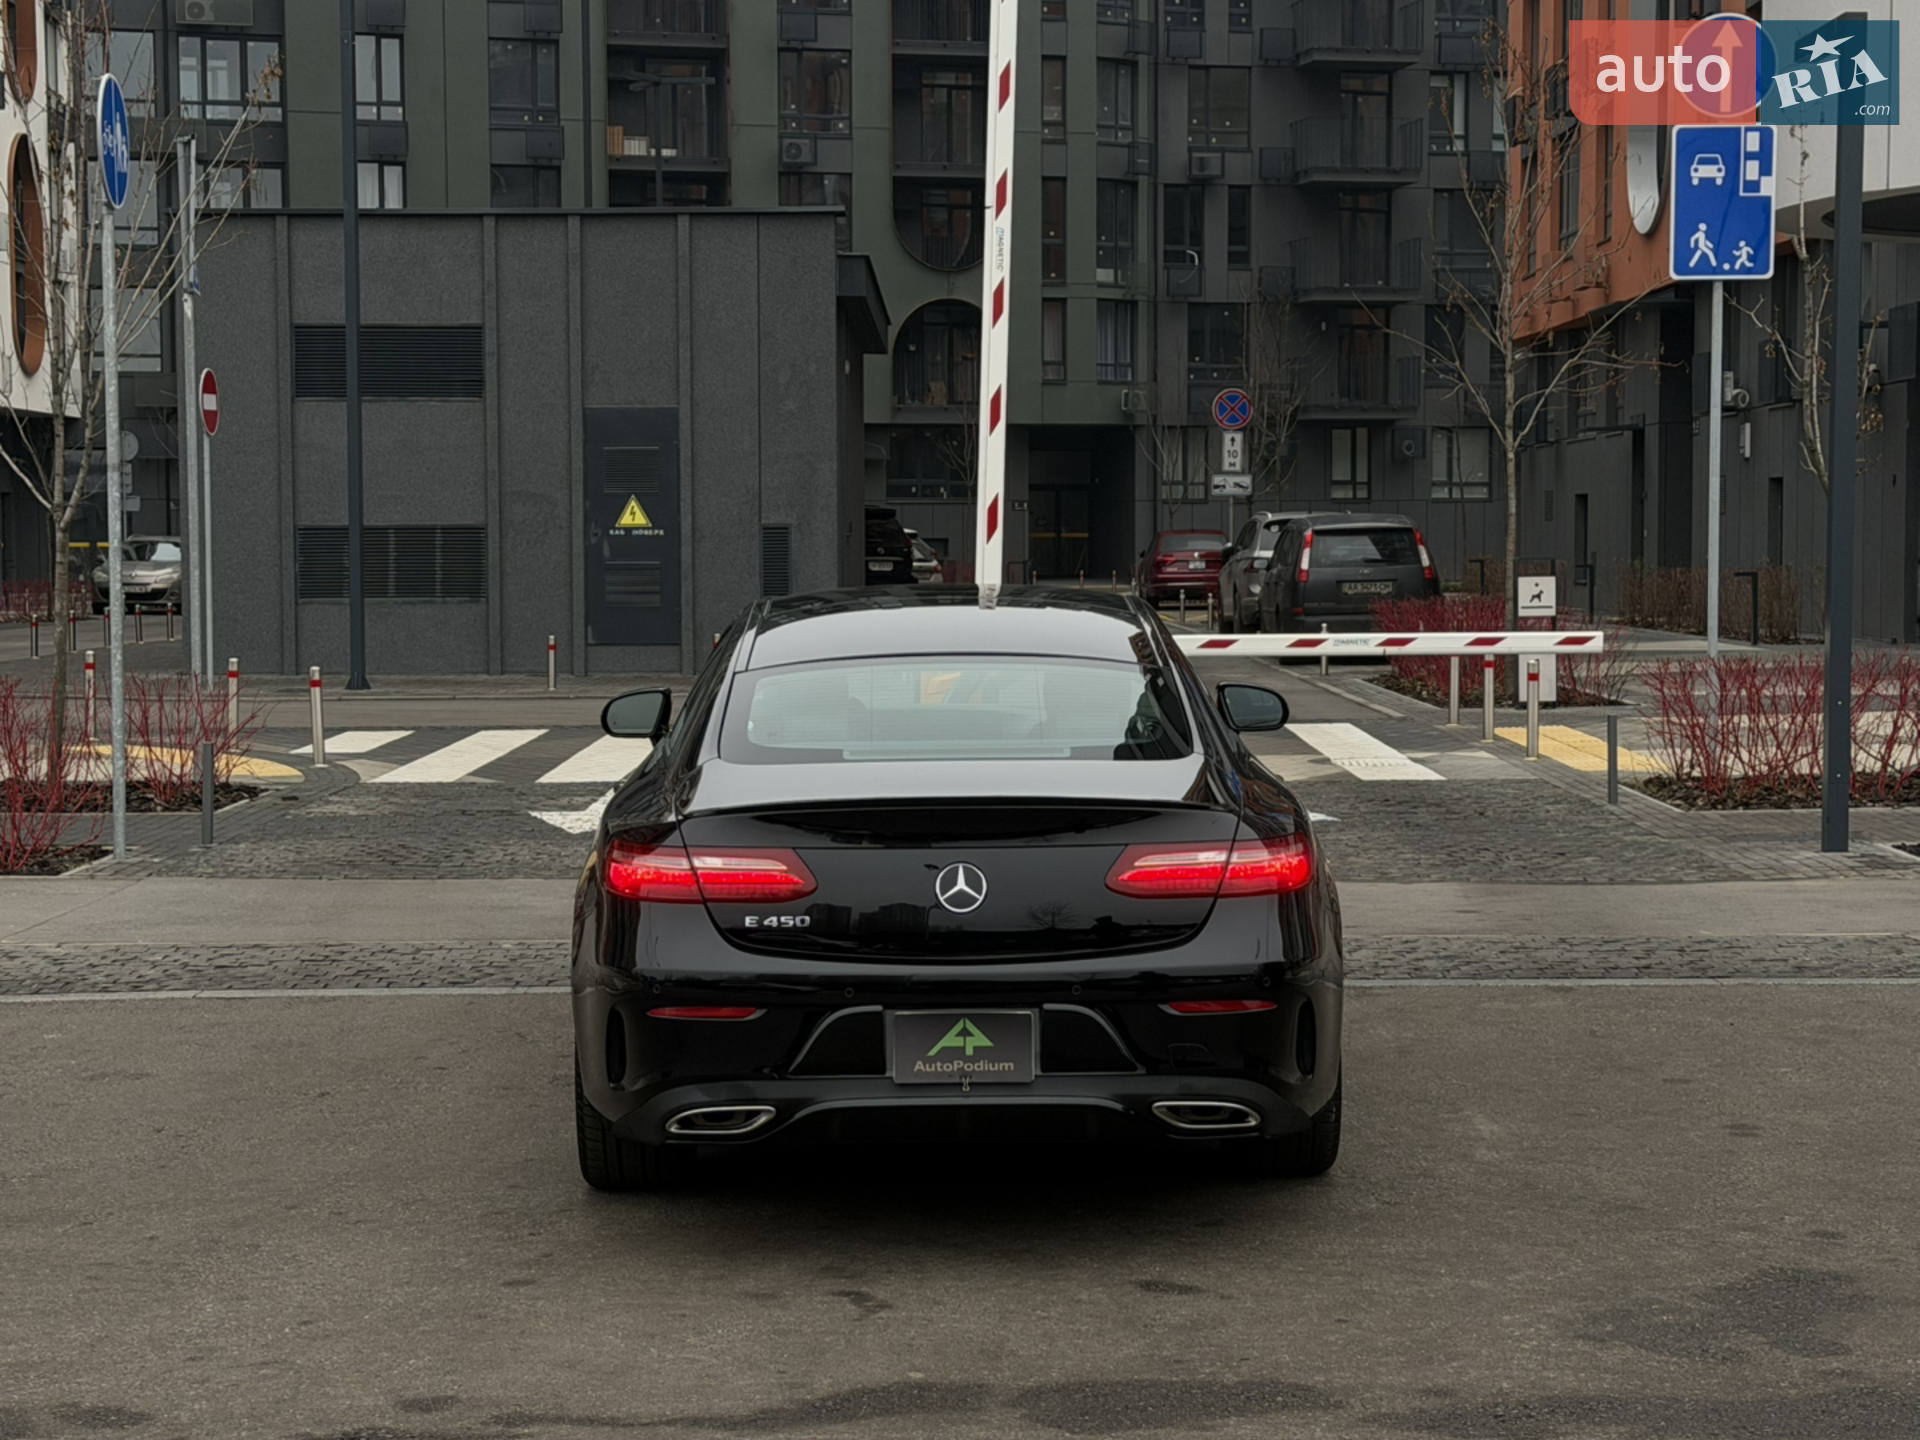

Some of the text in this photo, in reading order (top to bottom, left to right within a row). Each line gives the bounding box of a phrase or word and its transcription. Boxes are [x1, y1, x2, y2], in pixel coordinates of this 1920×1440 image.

[1226, 450, 1239, 459] 10
[745, 915, 811, 928] E 450
[913, 1060, 1015, 1073] AutoPodium
